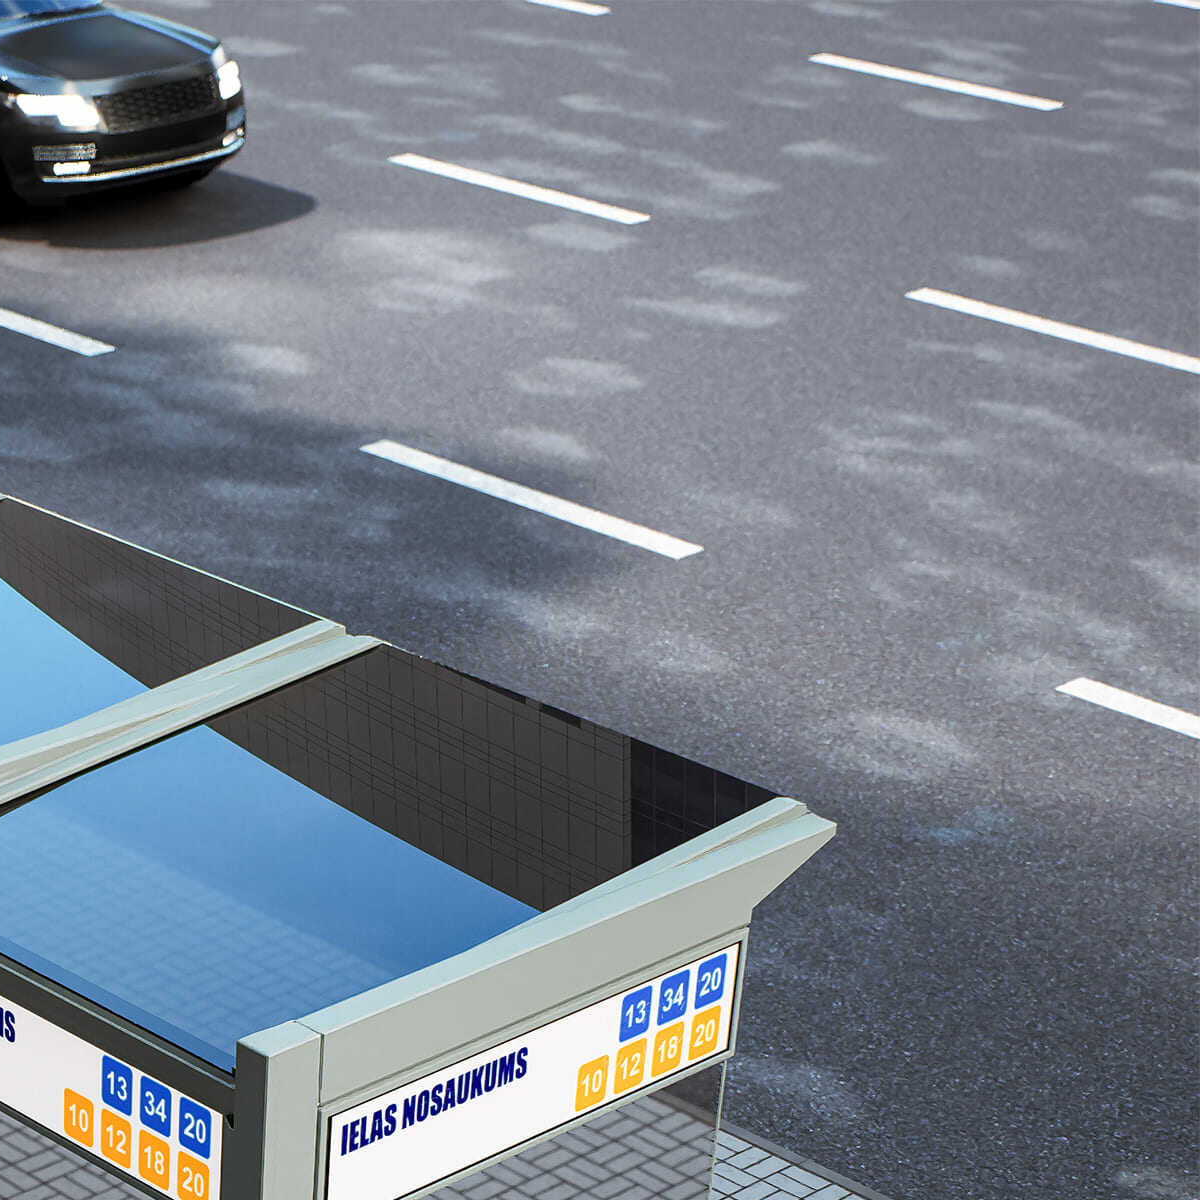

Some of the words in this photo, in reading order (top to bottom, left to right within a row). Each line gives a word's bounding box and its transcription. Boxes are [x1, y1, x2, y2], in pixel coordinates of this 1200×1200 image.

[627, 1000, 647, 1028] 13
[663, 983, 684, 1012] 34
[700, 967, 722, 996] 20
[582, 1069, 603, 1097] 10
[620, 1052, 641, 1081] 12
[658, 1035, 678, 1063] 18
[694, 1019, 715, 1047] 20
[106, 1071, 128, 1101] 13
[144, 1091, 168, 1122] 34
[183, 1112, 206, 1144] 20
[340, 1103, 397, 1157] IELAS
[402, 1047, 529, 1130] NOSAUKUMS
[69, 1103, 89, 1133] 10
[105, 1124, 127, 1155] 12
[143, 1146, 165, 1175] 18
[182, 1166, 204, 1197] 20
